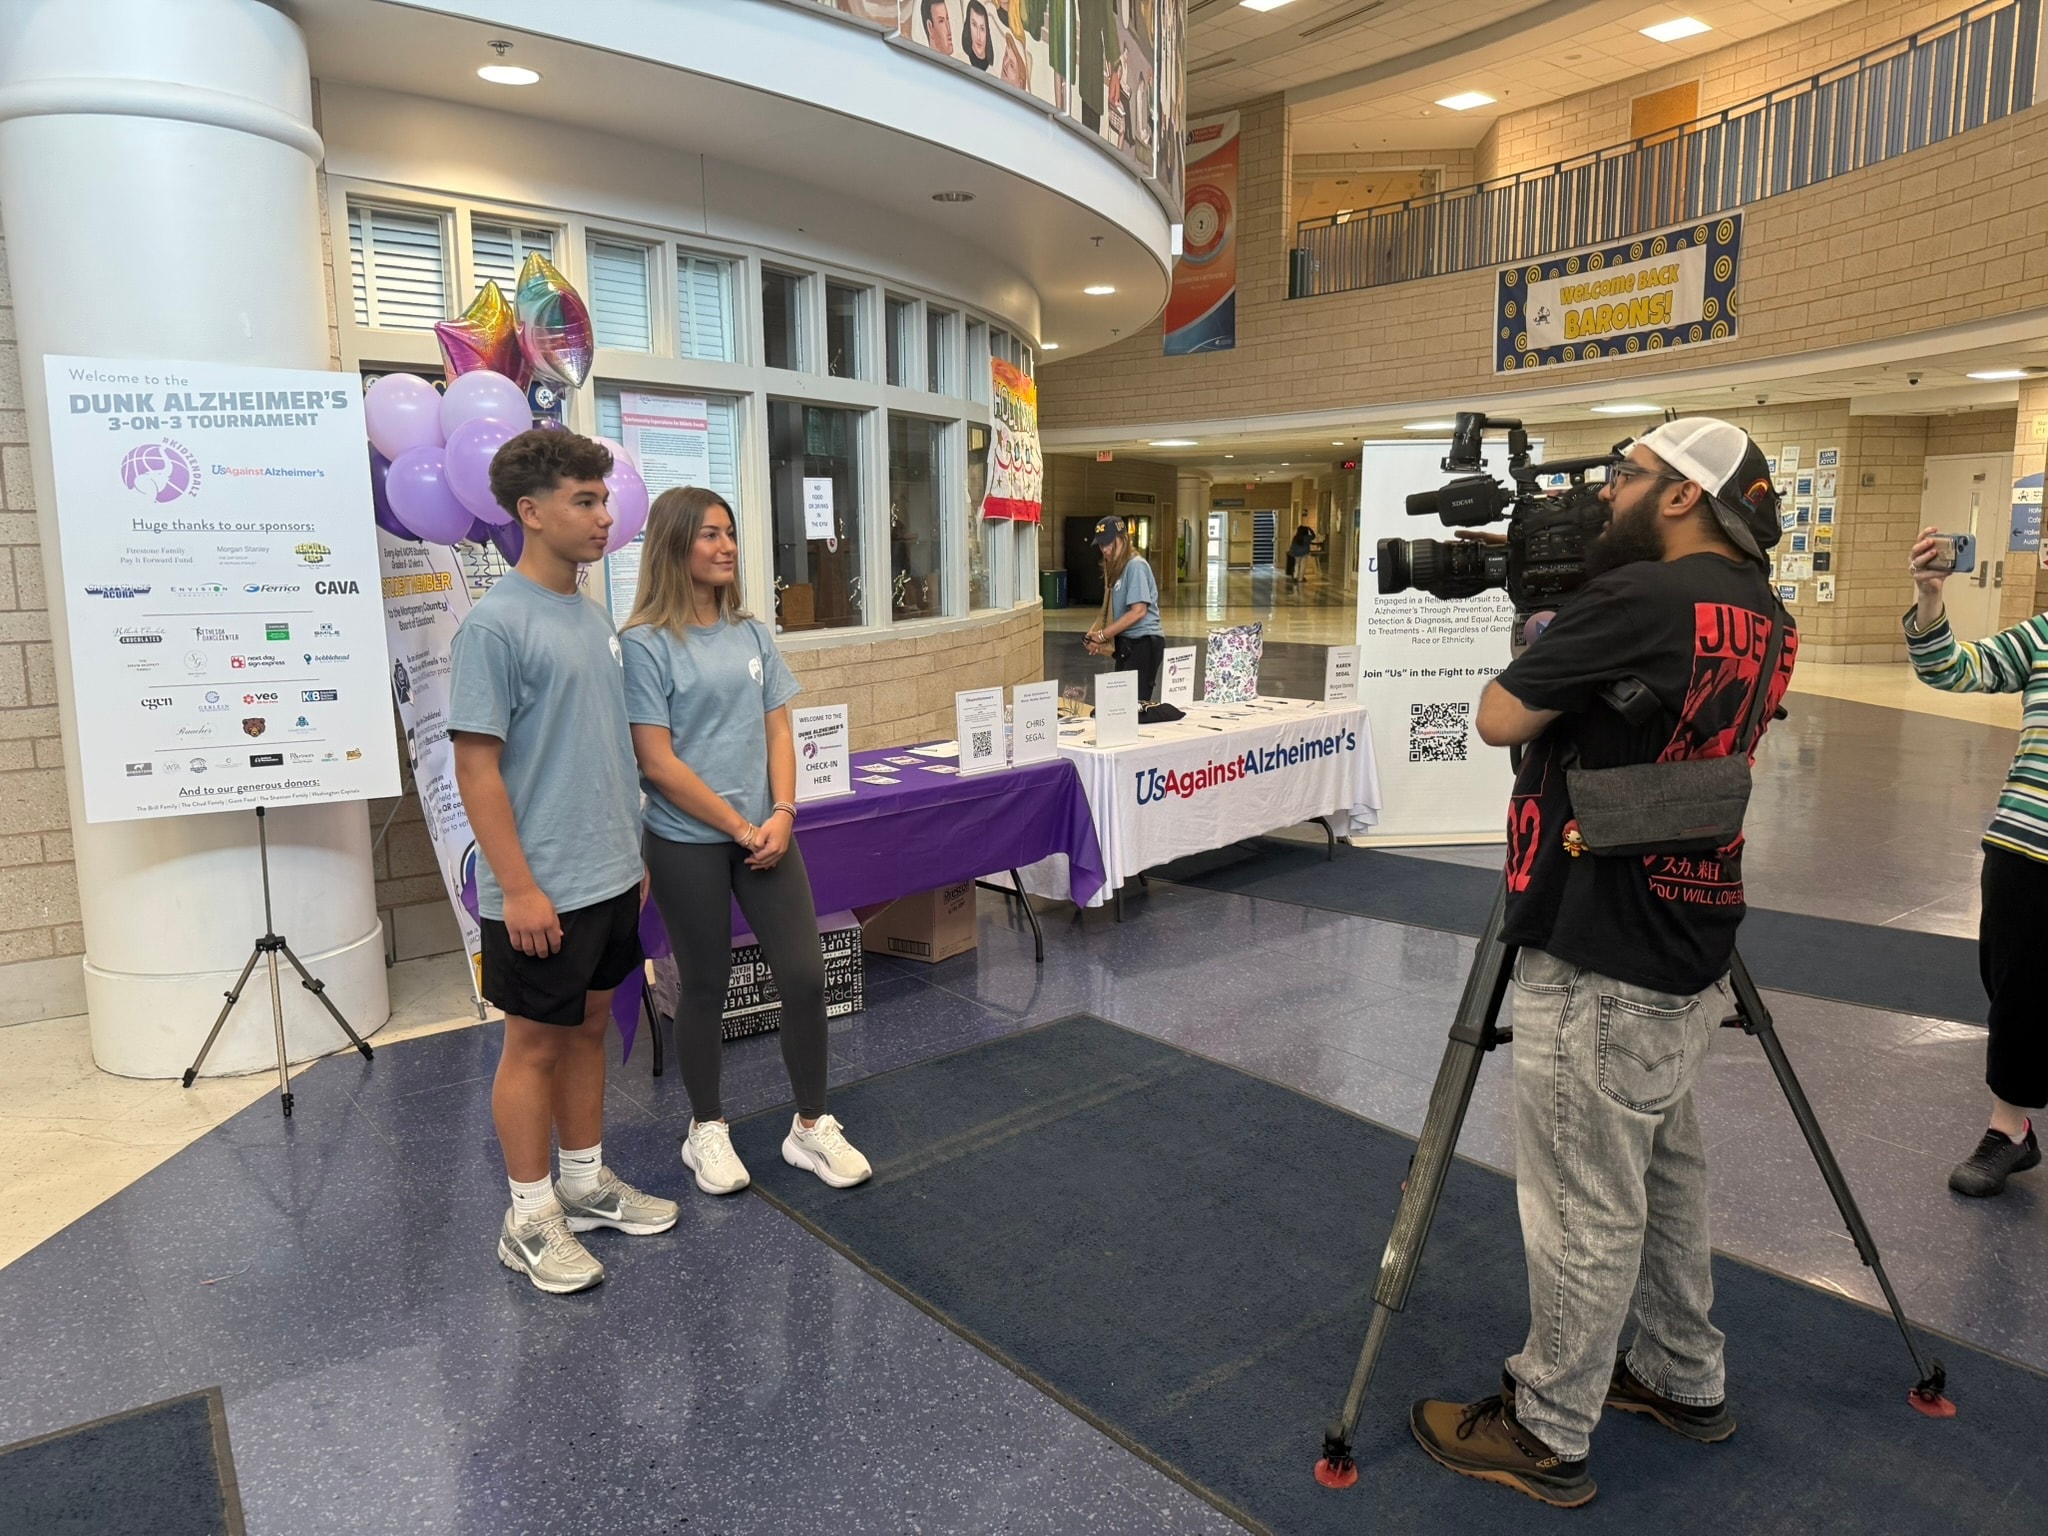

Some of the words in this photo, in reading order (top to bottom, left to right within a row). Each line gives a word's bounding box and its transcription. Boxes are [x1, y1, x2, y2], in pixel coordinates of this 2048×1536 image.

[1637, 264, 1680, 291] BACK
[1564, 290, 1673, 340] BARONS!
[69, 369, 140, 385] Welcome
[145, 374, 160, 385] to
[165, 374, 188, 386] the
[69, 393, 156, 414] DUNK
[163, 390, 348, 412] ALZHEIMER'S
[108, 414, 182, 431] 3-ON-3
[190, 413, 318, 429] TOURNAMENT
[1819, 458, 1837, 466] JOYCE
[211, 464, 325, 478] UsAgainstAlzheimer's
[1452, 498, 1474, 507] XDCAM
[132, 518, 169, 532] Huge
[172, 519, 214, 531] thanks
[219, 521, 232, 531] to
[235, 521, 256, 531] our
[259, 520, 315, 533] sponsors:
[162, 547, 185, 555] Family
[315, 581, 360, 595] CAVA
[414, 572, 452, 594] MEMBER
[103, 590, 134, 599] ACURA
[1374, 598, 1407, 607] Engaged
[401, 604, 423, 617] Montgomery
[422, 601, 447, 614] County
[1374, 607, 1417, 615] Alzheimer's
[1421, 607, 1450, 615] Through
[1453, 606, 1494, 614] Prevention,
[399, 620, 411, 631] Board
[1368, 617, 1404, 625] Detection
[1415, 616, 1452, 624] Diagnosis,
[1379, 627, 1419, 635] Treatments
[1439, 626, 1479, 634] Regardless
[1442, 636, 1475, 644] Ethnicity.
[1363, 670, 1382, 678] Join
[1421, 669, 1436, 677] the
[1439, 668, 1462, 677] Fight
[1465, 668, 1474, 676] to
[1026, 719, 1045, 728] CHRIS
[1025, 733, 1045, 742] SEGAL
[806, 760, 838, 771] CHECK-IN
[1136, 728, 1356, 805] UsAgainstAlzheimer's
[814, 775, 831, 784] HERE
[180, 786, 200, 796] And
[237, 781, 281, 793] generous
[285, 779, 320, 787] donors:
[440, 781, 453, 791] day!
[442, 803, 451, 811] QR
[1648, 878, 1678, 900] YOU
[1683, 887, 1714, 905] WILL
[828, 973, 851, 985] USA
